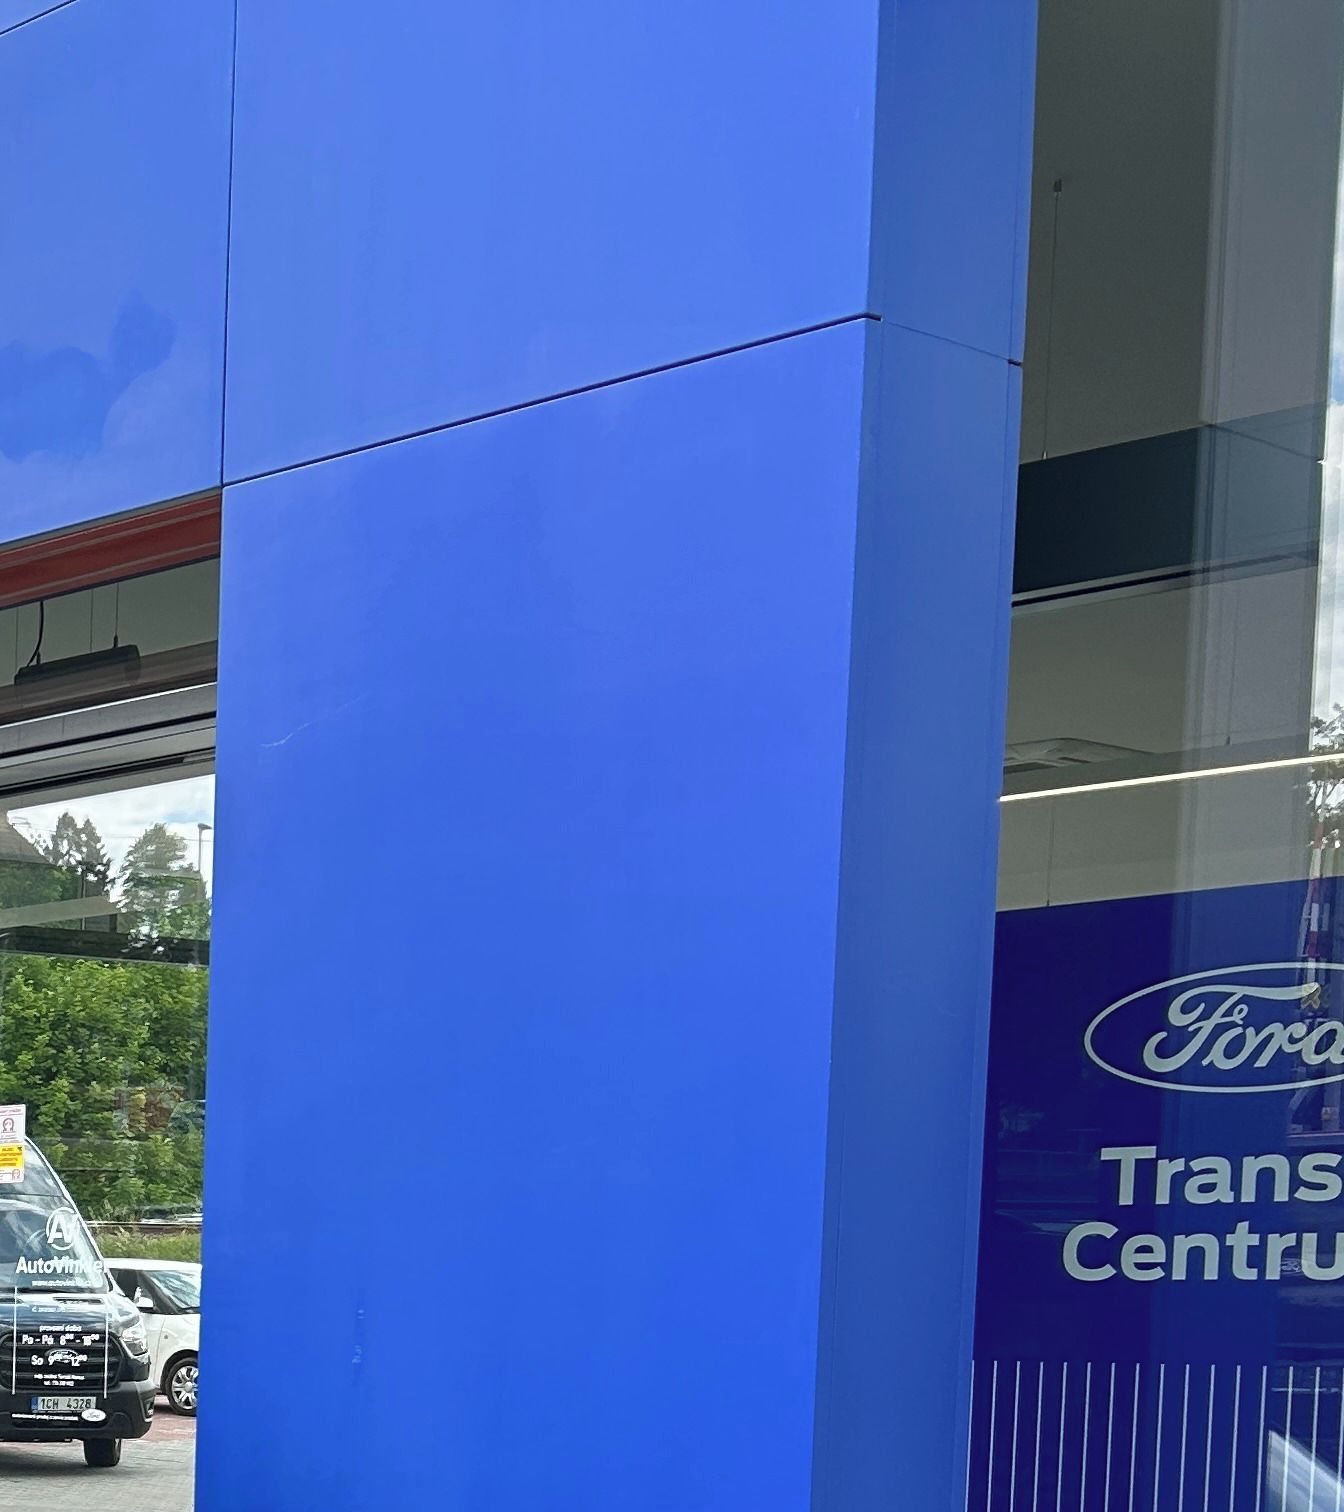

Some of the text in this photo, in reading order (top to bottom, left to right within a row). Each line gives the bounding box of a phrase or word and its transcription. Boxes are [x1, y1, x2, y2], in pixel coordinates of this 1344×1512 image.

[1100, 1145, 1344, 1206] Trans
[1062, 1220, 1344, 1282] Centru
[41, 1398, 93, 1411] 1CH 4328
